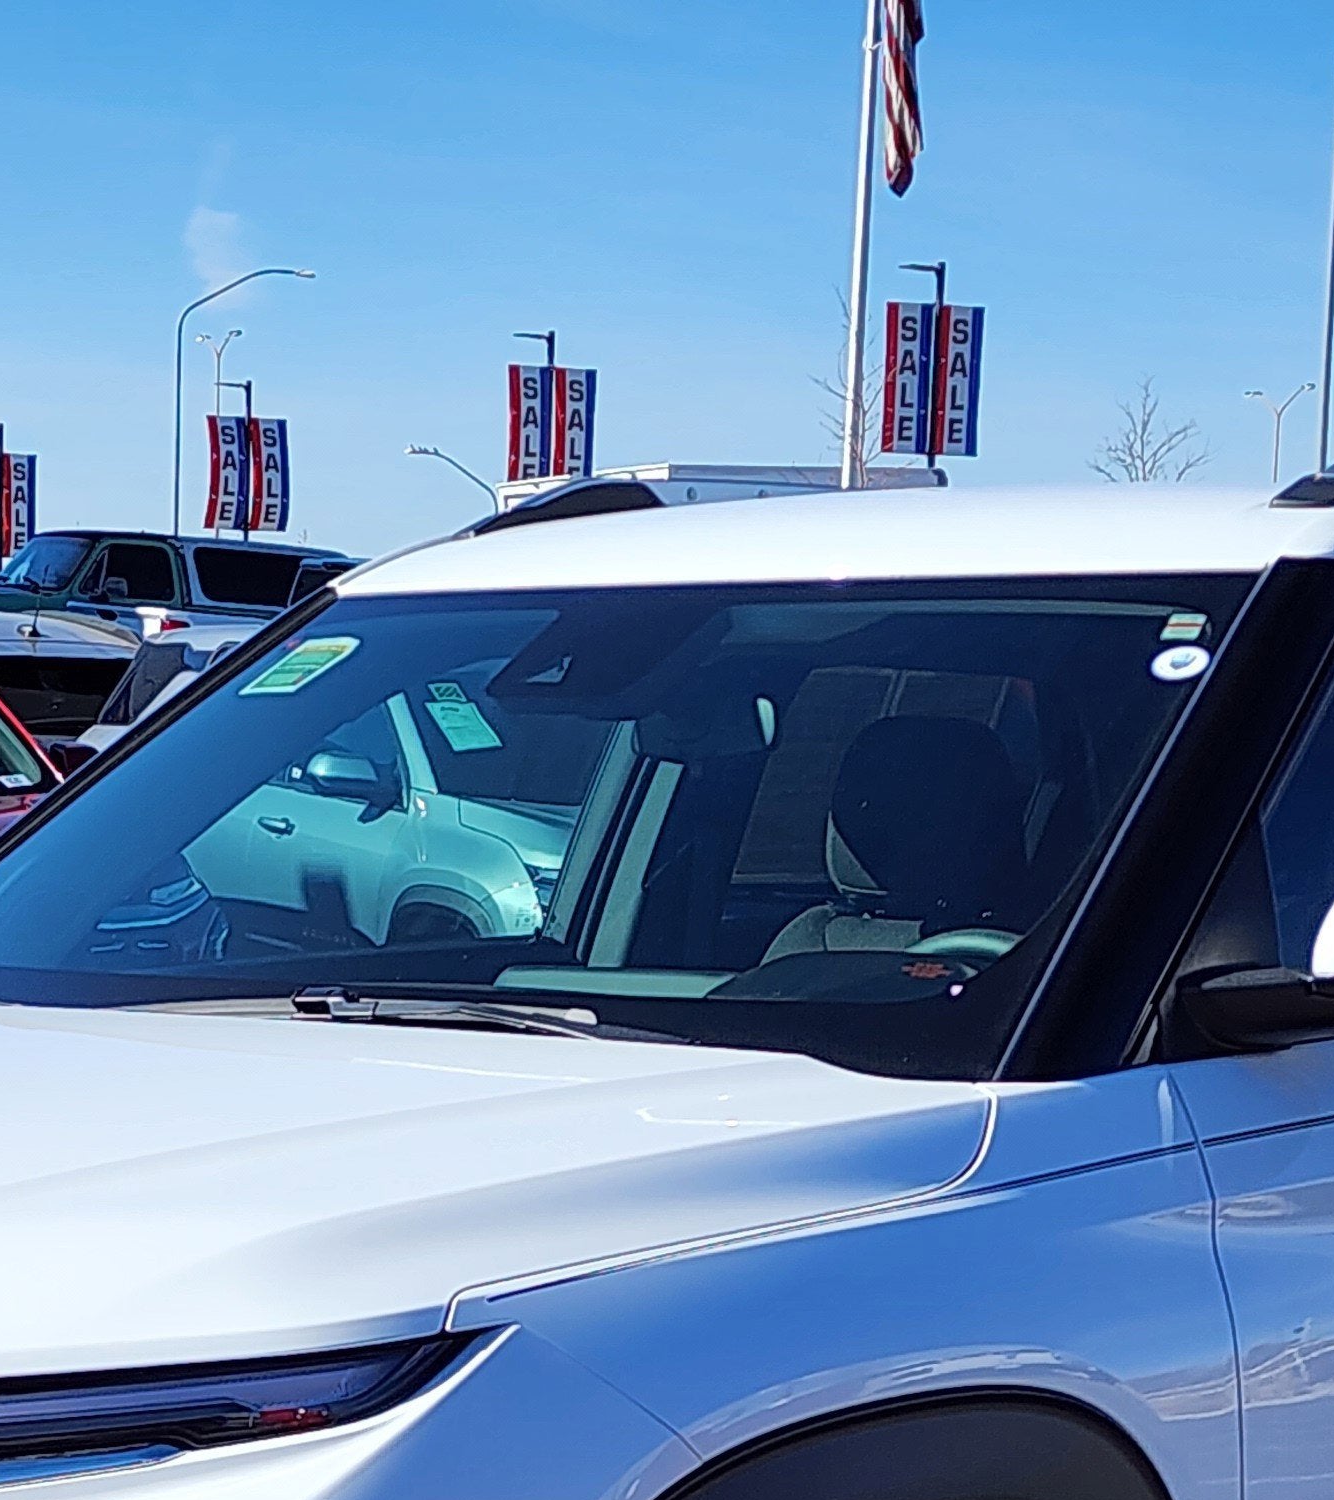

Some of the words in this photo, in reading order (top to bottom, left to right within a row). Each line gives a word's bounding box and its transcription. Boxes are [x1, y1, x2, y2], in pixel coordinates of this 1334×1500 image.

[897, 316, 918, 442] SALE
[947, 318, 969, 444] SALE
[13, 462, 27, 550] SALE
[218, 425, 237, 521] SALE
[262, 427, 280, 523] SALE
